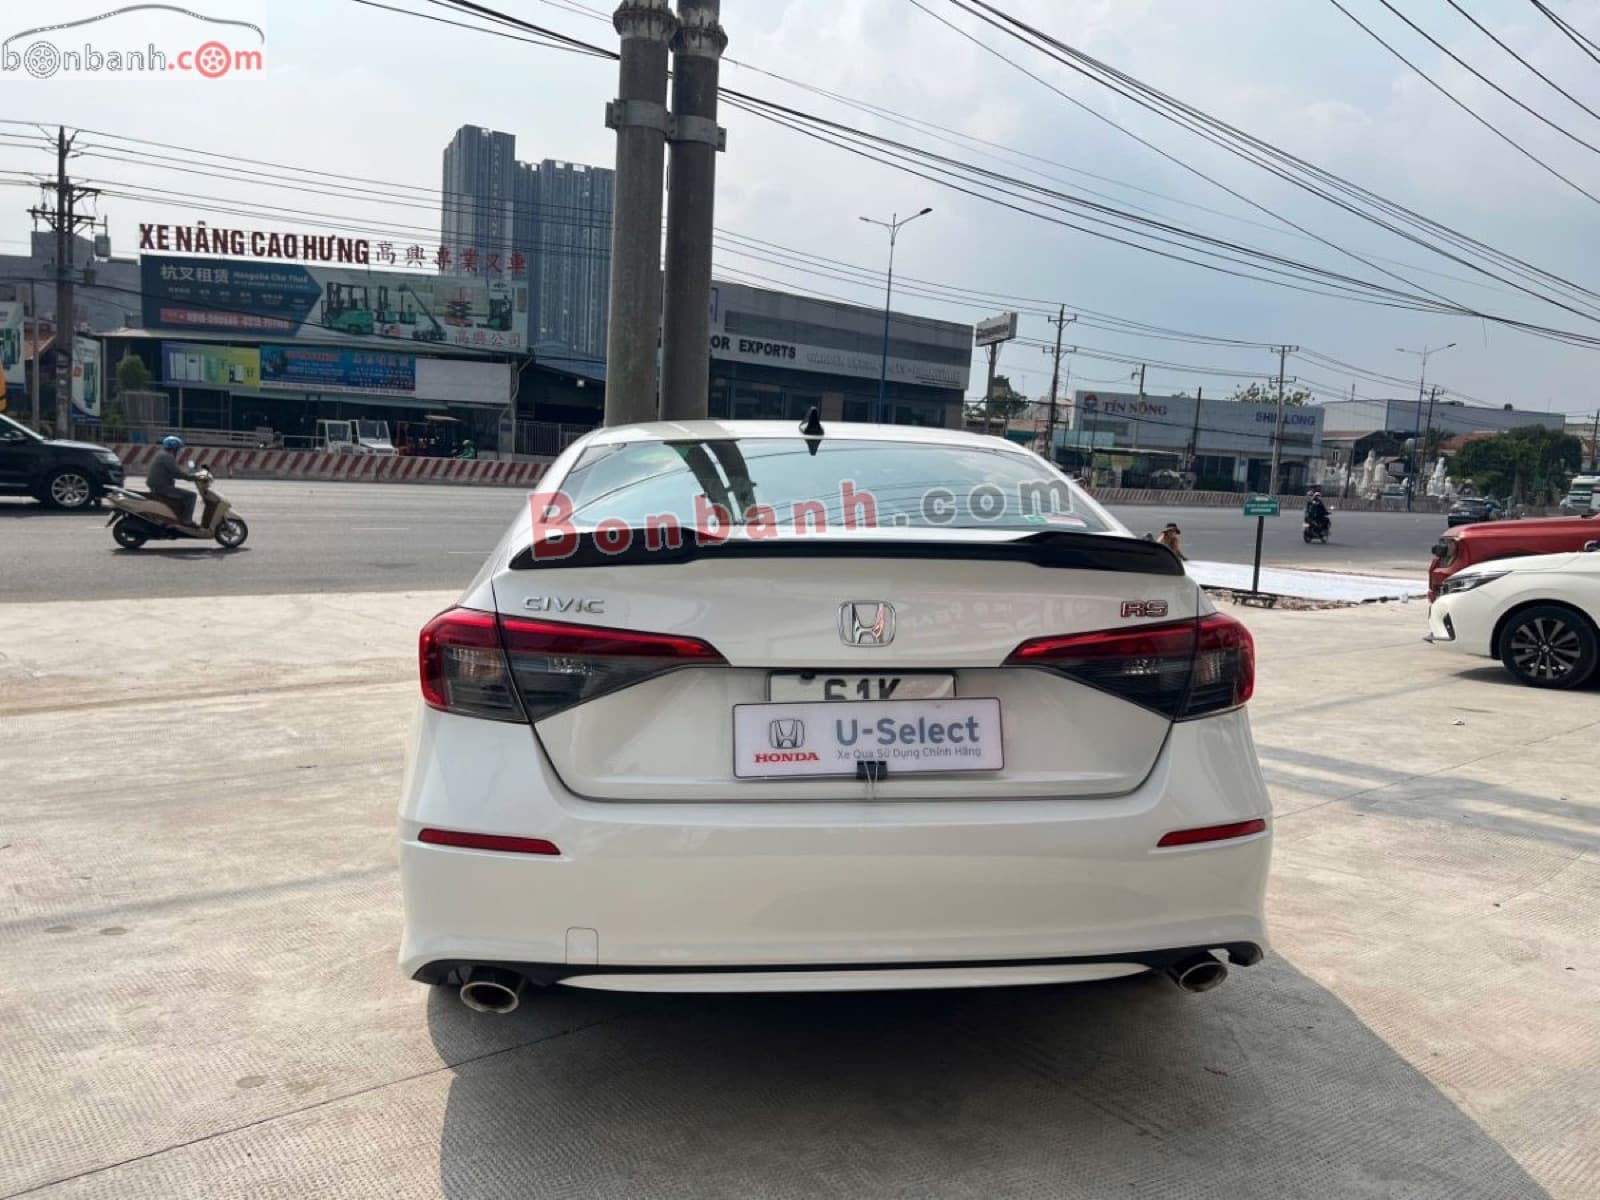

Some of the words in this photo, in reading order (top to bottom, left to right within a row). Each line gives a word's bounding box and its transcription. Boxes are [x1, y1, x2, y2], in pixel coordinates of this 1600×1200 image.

[139, 223, 169, 250] XE
[175, 220, 245, 256] NÂNG
[251, 231, 297, 258] CAO
[303, 234, 369, 264] HƯNG
[738, 339, 797, 360] EXPORTS
[524, 596, 605, 614] CIVIC
[1120, 600, 1169, 618] RS
[836, 715, 980, 746] U-Select
[753, 751, 821, 764] HONDA
[837, 750, 850, 760] Xe
